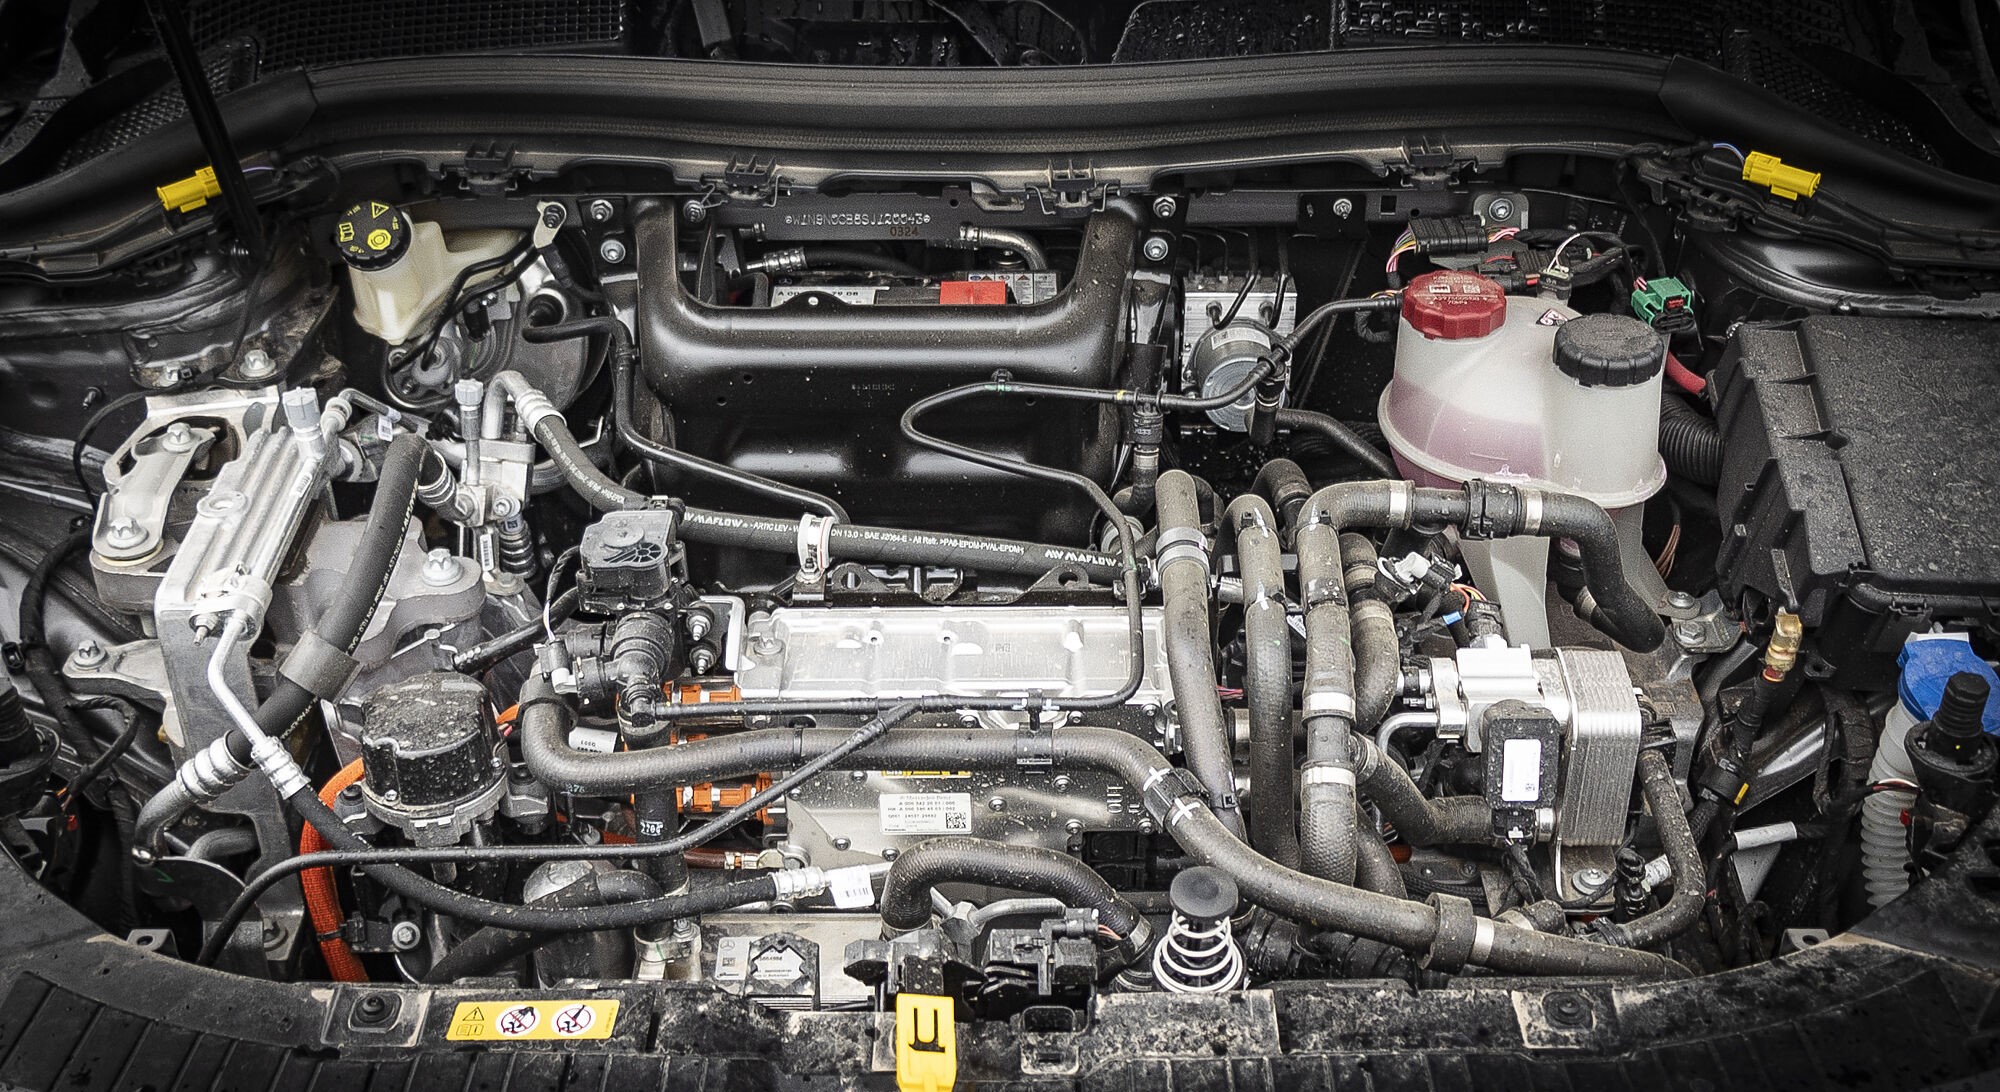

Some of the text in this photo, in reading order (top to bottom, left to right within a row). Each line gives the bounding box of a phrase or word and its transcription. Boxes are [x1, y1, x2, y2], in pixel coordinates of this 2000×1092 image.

[889, 226, 919, 237] 0324
[775, 523, 789, 533] LEV
[865, 531, 880, 541] SAE
[1065, 551, 1118, 567] MAFLOW
